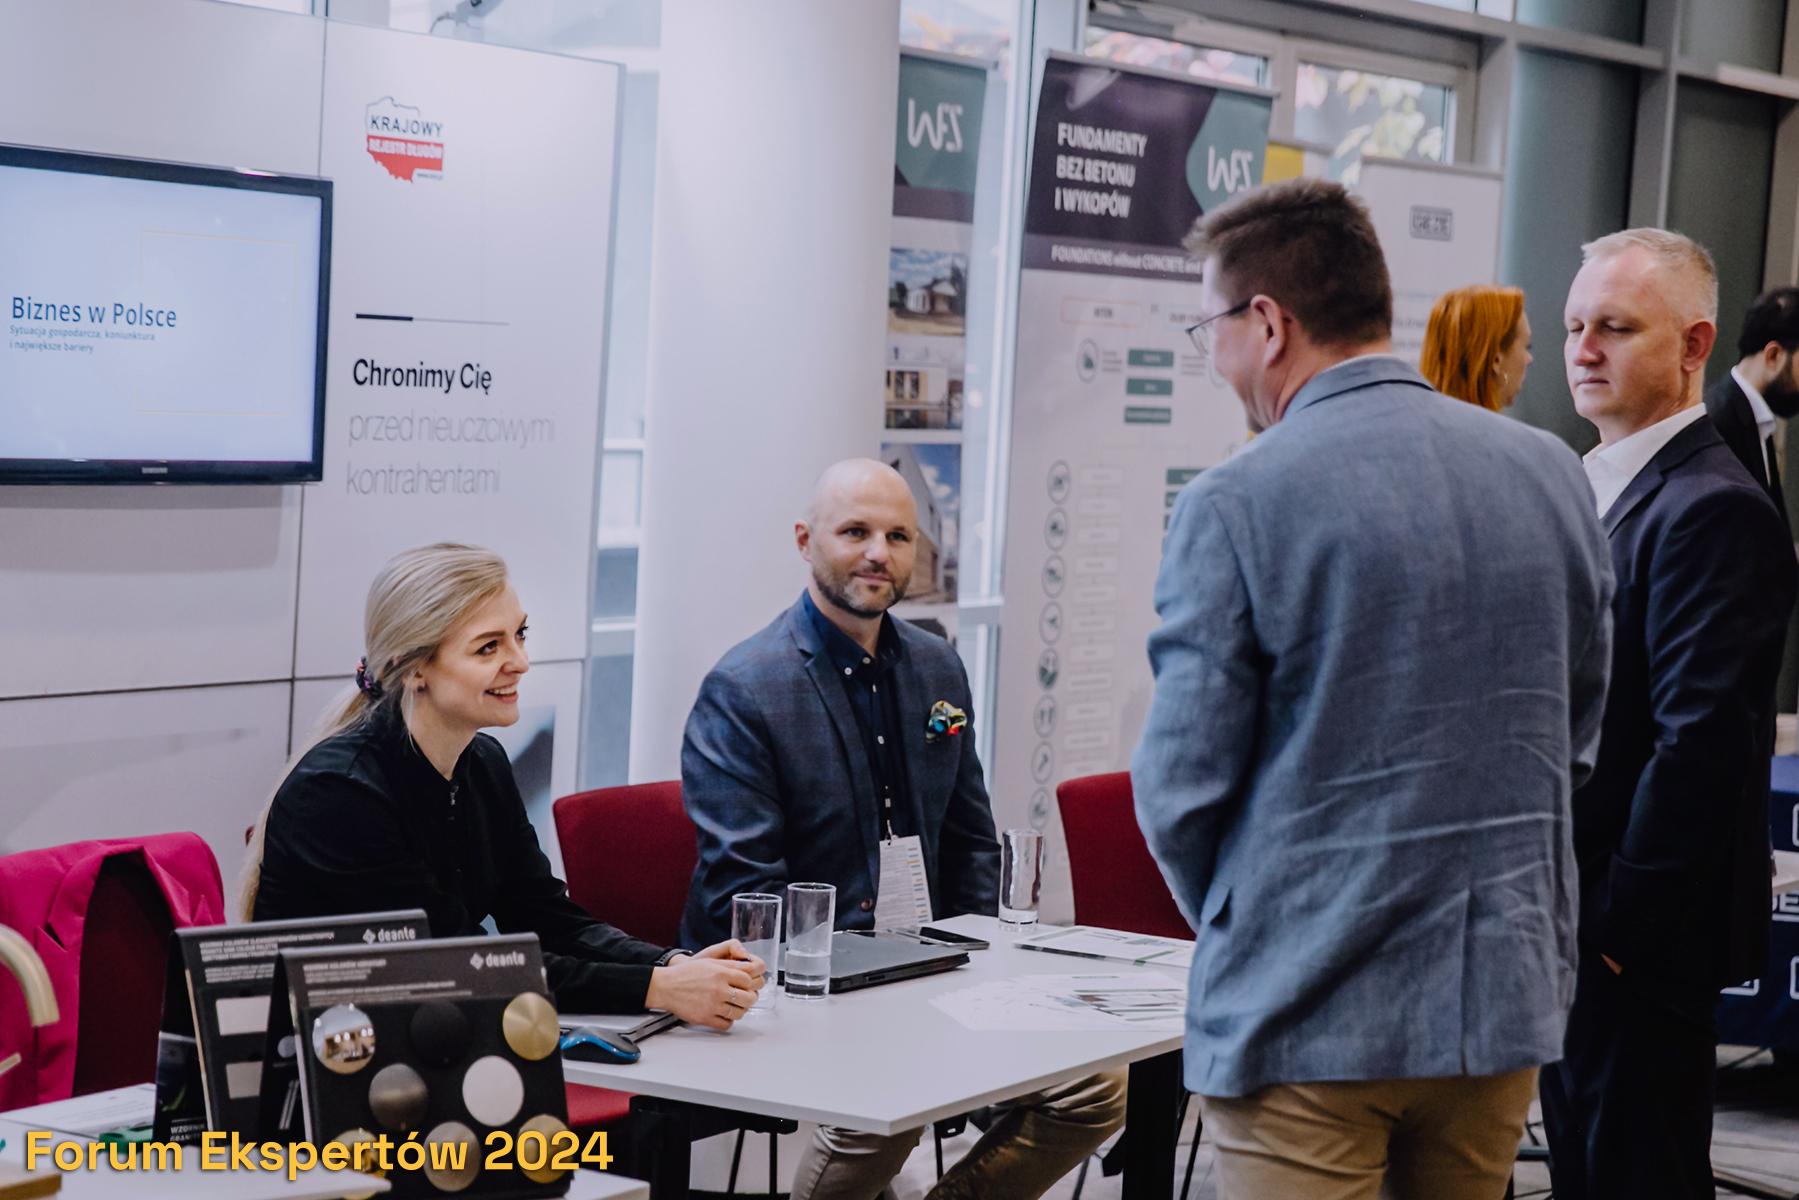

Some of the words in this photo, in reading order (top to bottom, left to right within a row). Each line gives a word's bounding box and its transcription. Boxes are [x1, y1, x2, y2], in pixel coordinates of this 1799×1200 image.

[371, 115, 443, 137] KRAJOWY
[1057, 122, 1148, 157] FUNDAMENTY
[1056, 154, 1084, 181] BEZ
[1084, 158, 1136, 187] BETONU
[1054, 187, 1061, 210] I
[1063, 186, 1131, 218] WYKOPÓW
[12, 296, 81, 322] Biznes
[88, 305, 105, 324] w
[113, 303, 177, 327] Polsce
[9, 324, 47, 338] Sytuacja
[353, 358, 455, 393] Chronimy
[460, 363, 492, 395] Cię
[349, 409, 414, 448] przed
[418, 410, 555, 449] nieuczciwymi
[346, 462, 501, 496] kontrahentami
[378, 926, 416, 942] deante
[486, 951, 525, 968] deante
